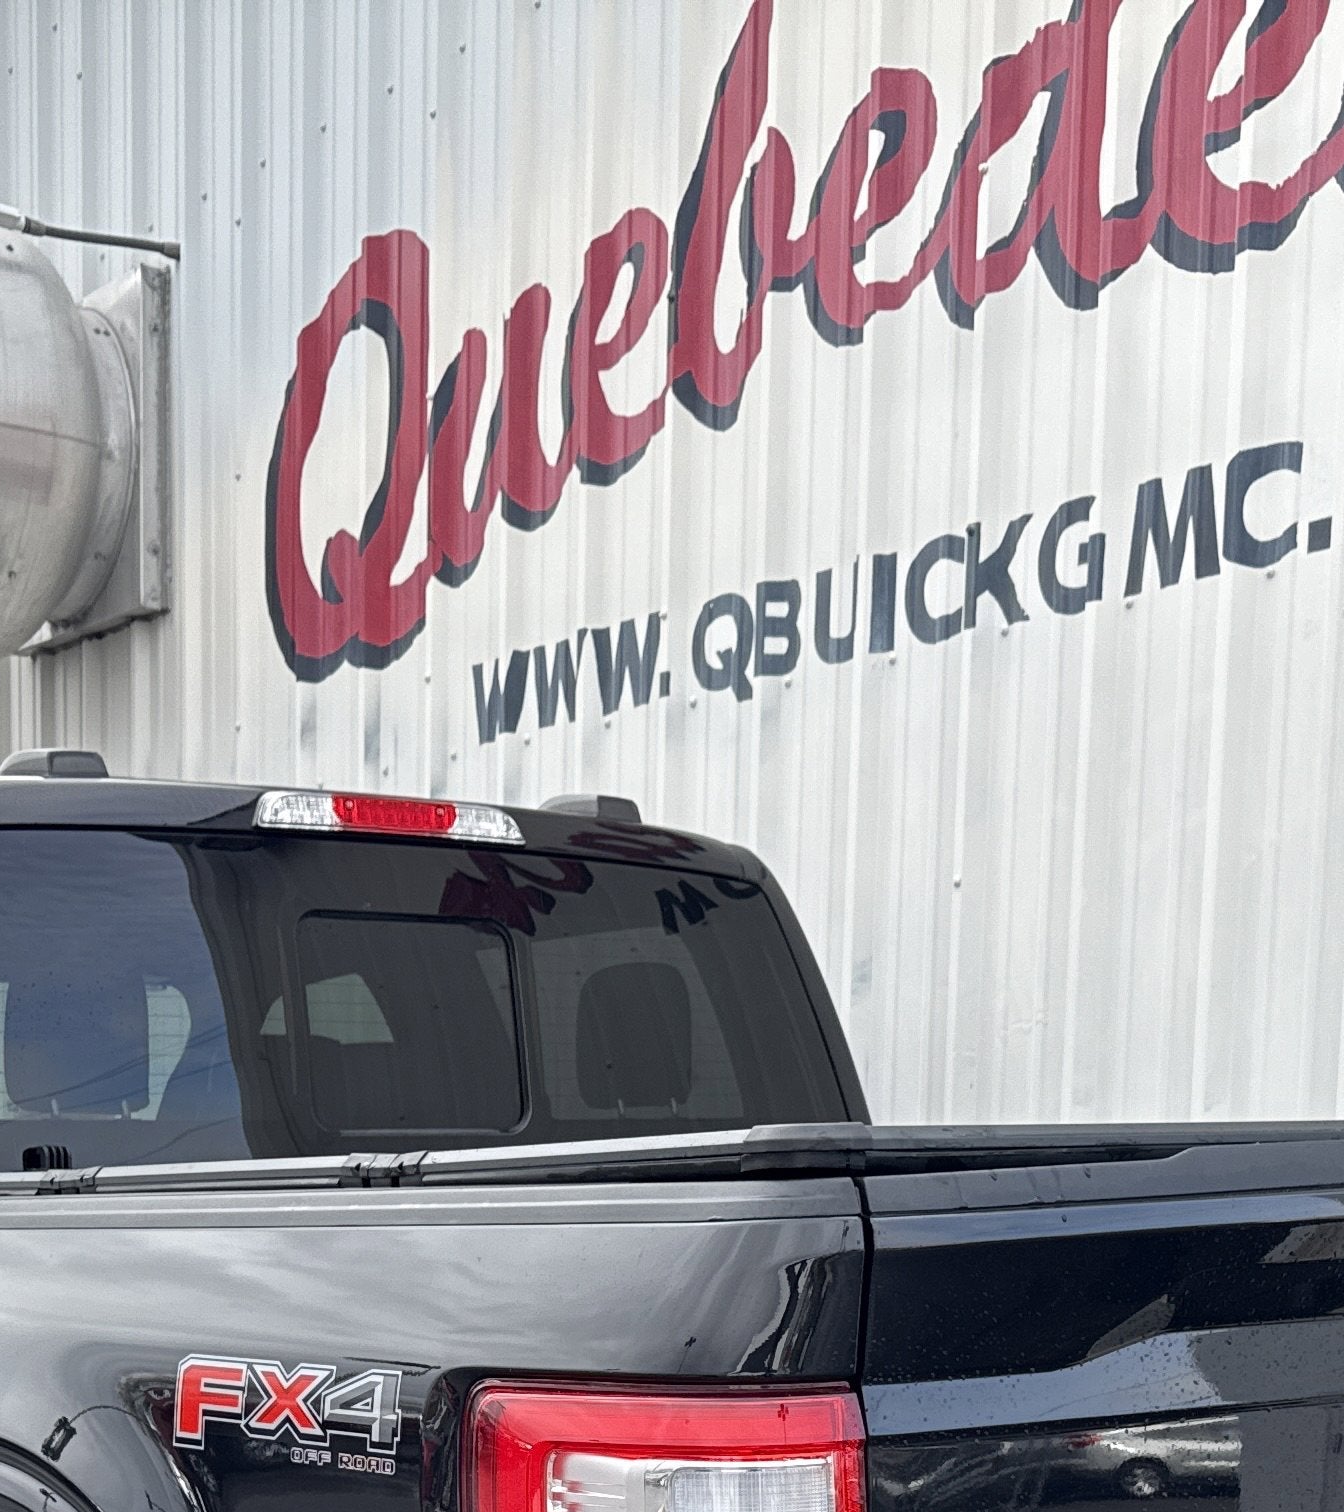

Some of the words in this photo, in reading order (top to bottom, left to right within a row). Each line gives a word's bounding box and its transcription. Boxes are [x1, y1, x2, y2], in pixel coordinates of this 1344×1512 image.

[172, 1353, 402, 1454] FX4
[290, 1447, 332, 1465] OFF
[338, 1453, 396, 1475] ROAD
